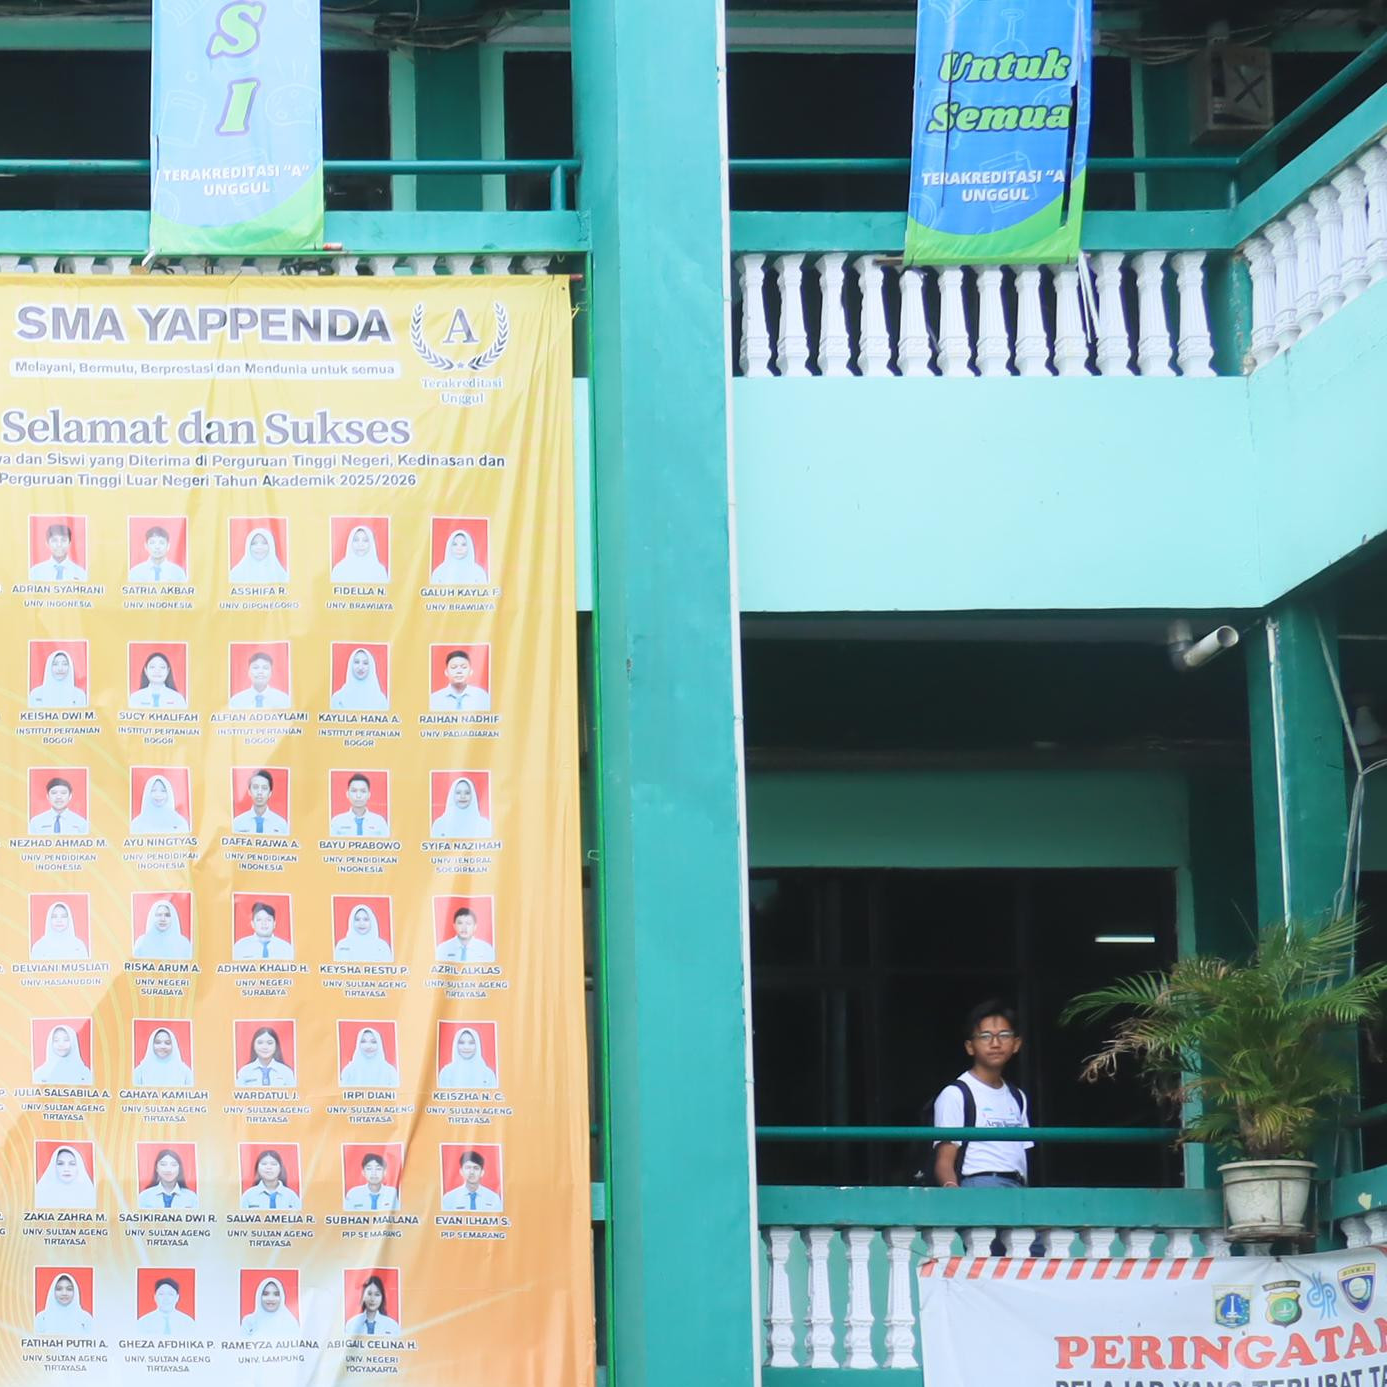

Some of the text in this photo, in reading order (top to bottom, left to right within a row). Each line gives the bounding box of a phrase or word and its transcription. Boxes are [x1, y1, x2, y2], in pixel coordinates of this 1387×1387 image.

[939, 48, 1070, 83] Untuk
[928, 101, 1069, 134] Semua
[163, 165, 279, 182] TERAKREDITASI
[922, 170, 1042, 186] TERAKREDITASI
[204, 182, 271, 196] UNGGUL
[962, 188, 1030, 202] UNGGUL
[17, 306, 124, 341] SMA
[138, 307, 392, 343] YAPPENDA
[442, 308, 479, 344] A
[15, 361, 394, 376] Melayani, Bermutu, Berprestasi dan Mendunia untuk semua
[422, 377, 502, 388] Terakreditasi
[441, 392, 484, 405] Unggul
[3, 409, 411, 445] Selamat dan Sukses
[15, 453, 42, 464] dan
[47, 453, 85, 465] Siswi
[90, 457, 124, 468] yang
[129, 455, 190, 466] Diterima
[196, 455, 207, 466] di
[213, 455, 287, 468] Perguruan
[293, 454, 336, 468] Tinggi
[341, 455, 393, 468] Negeri,
[398, 455, 474, 467] Kedinasan
[478, 456, 505, 467] dan
[0, 473, 416, 487] Perguruan Tinggi Luar Negeri Tahun Akademik 2025/2026
[122, 586, 195, 595] SATRIA AKBAR
